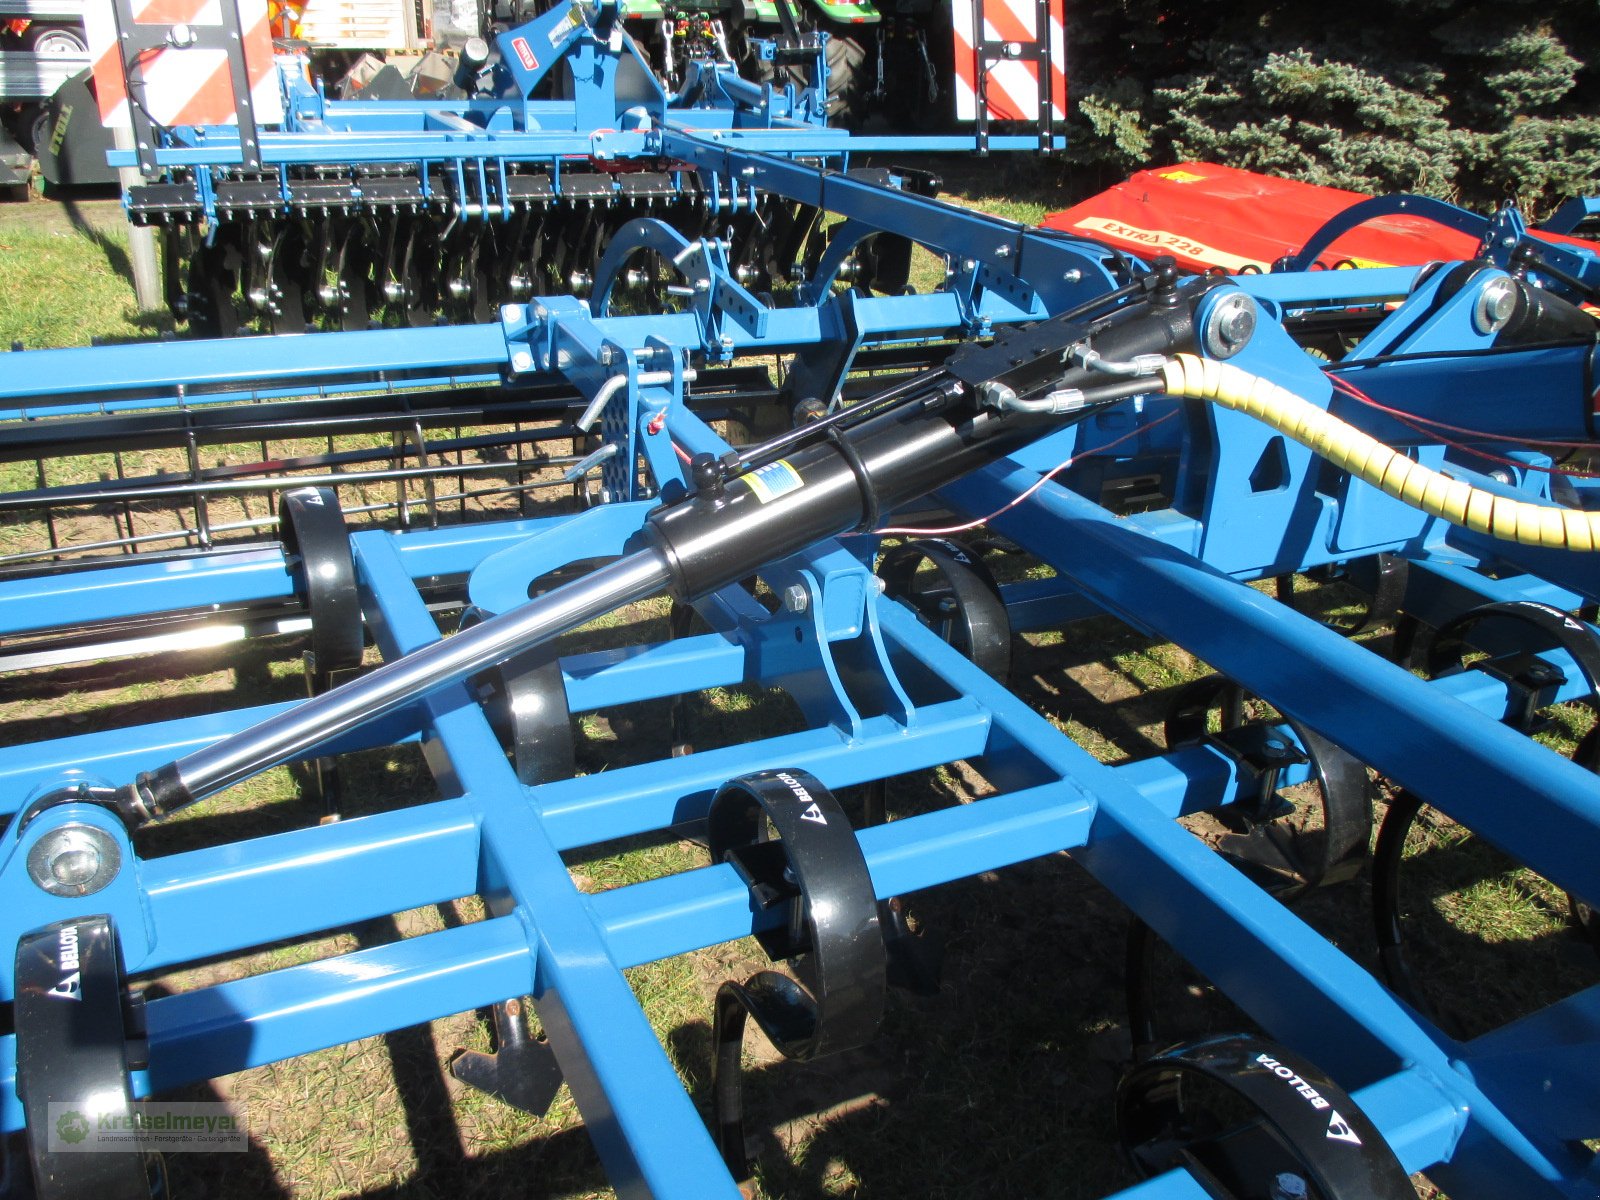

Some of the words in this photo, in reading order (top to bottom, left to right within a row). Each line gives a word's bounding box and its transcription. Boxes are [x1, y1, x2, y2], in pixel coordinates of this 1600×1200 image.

[1102, 223, 1160, 243] EXTRA
[1165, 237, 1204, 255] 228
[776, 772, 813, 802] BELLOTA
[60, 925, 80, 970] BELLOTA
[1256, 1053, 1330, 1109] BELLOTA
